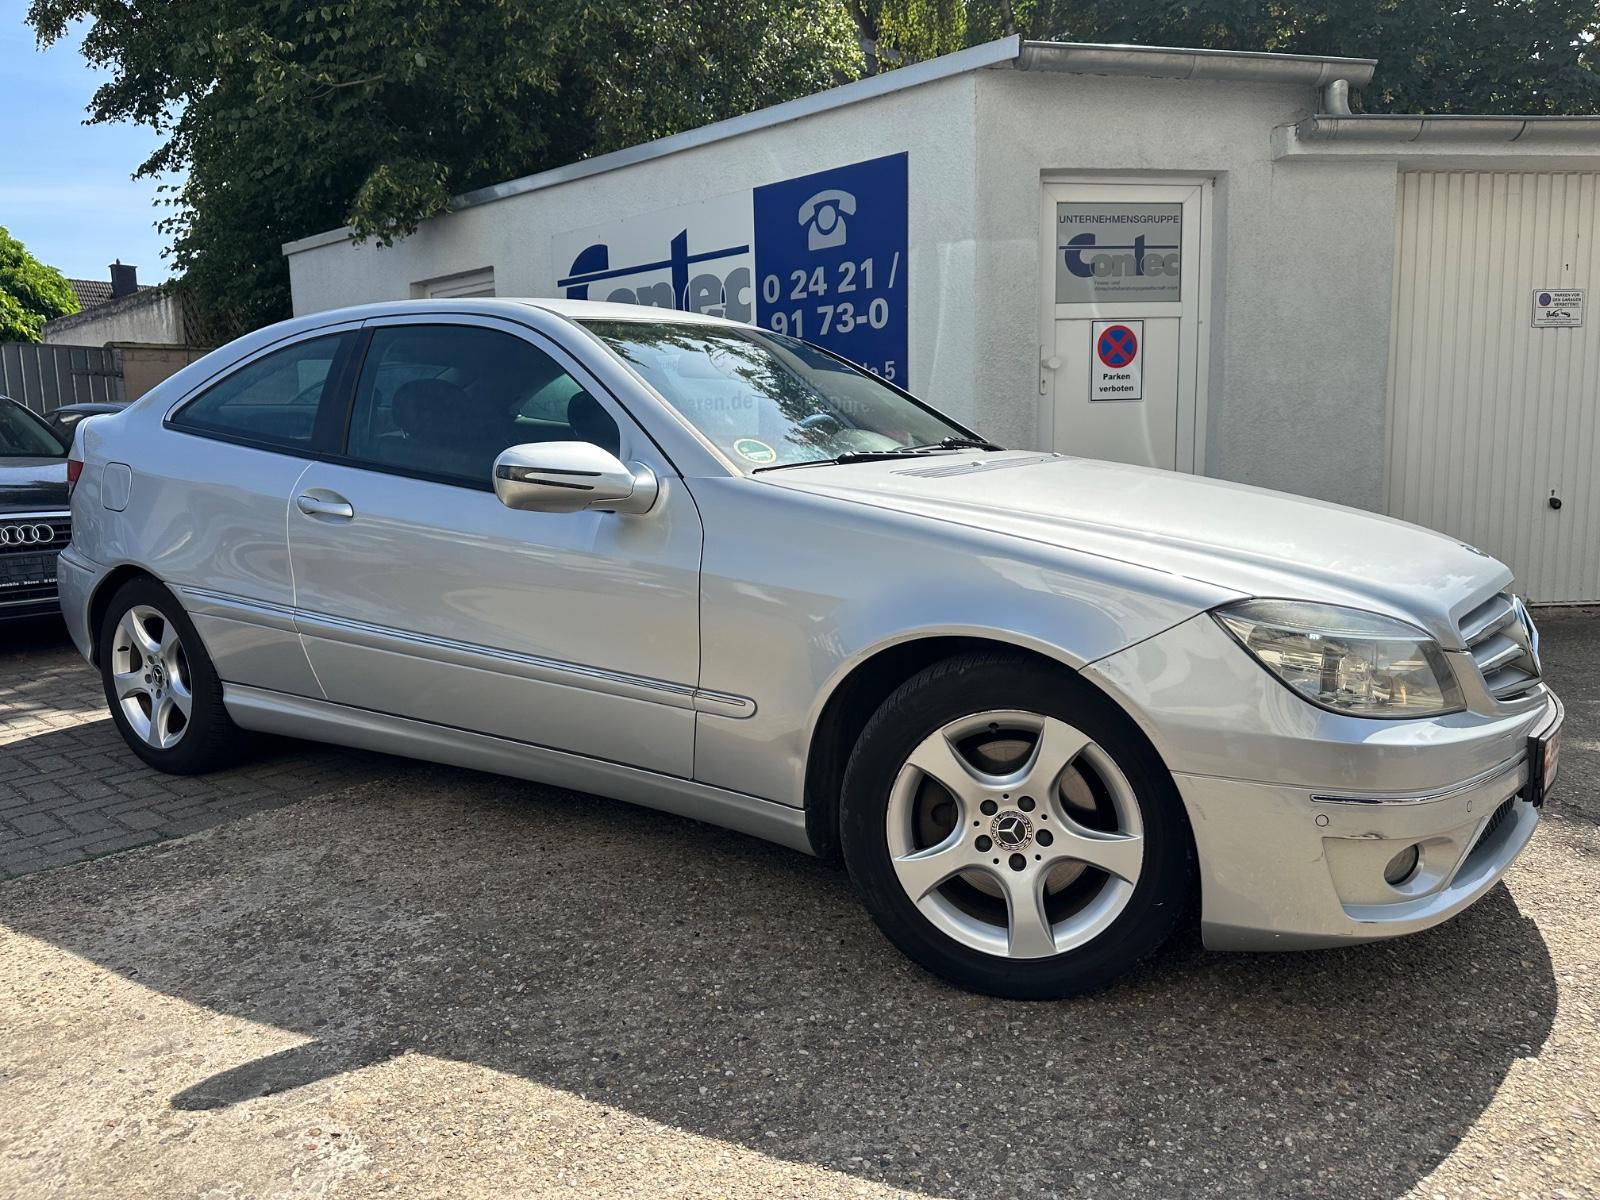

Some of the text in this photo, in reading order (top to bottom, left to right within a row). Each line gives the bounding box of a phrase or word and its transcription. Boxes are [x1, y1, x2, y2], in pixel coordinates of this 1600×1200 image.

[1059, 215, 1180, 224] UNTERNEHMENSGRUPPE
[1058, 232, 1179, 278] Contec
[763, 251, 900, 303] 0 24 21 /
[770, 297, 889, 338] 91 73-0
[884, 360, 896, 380] 5
